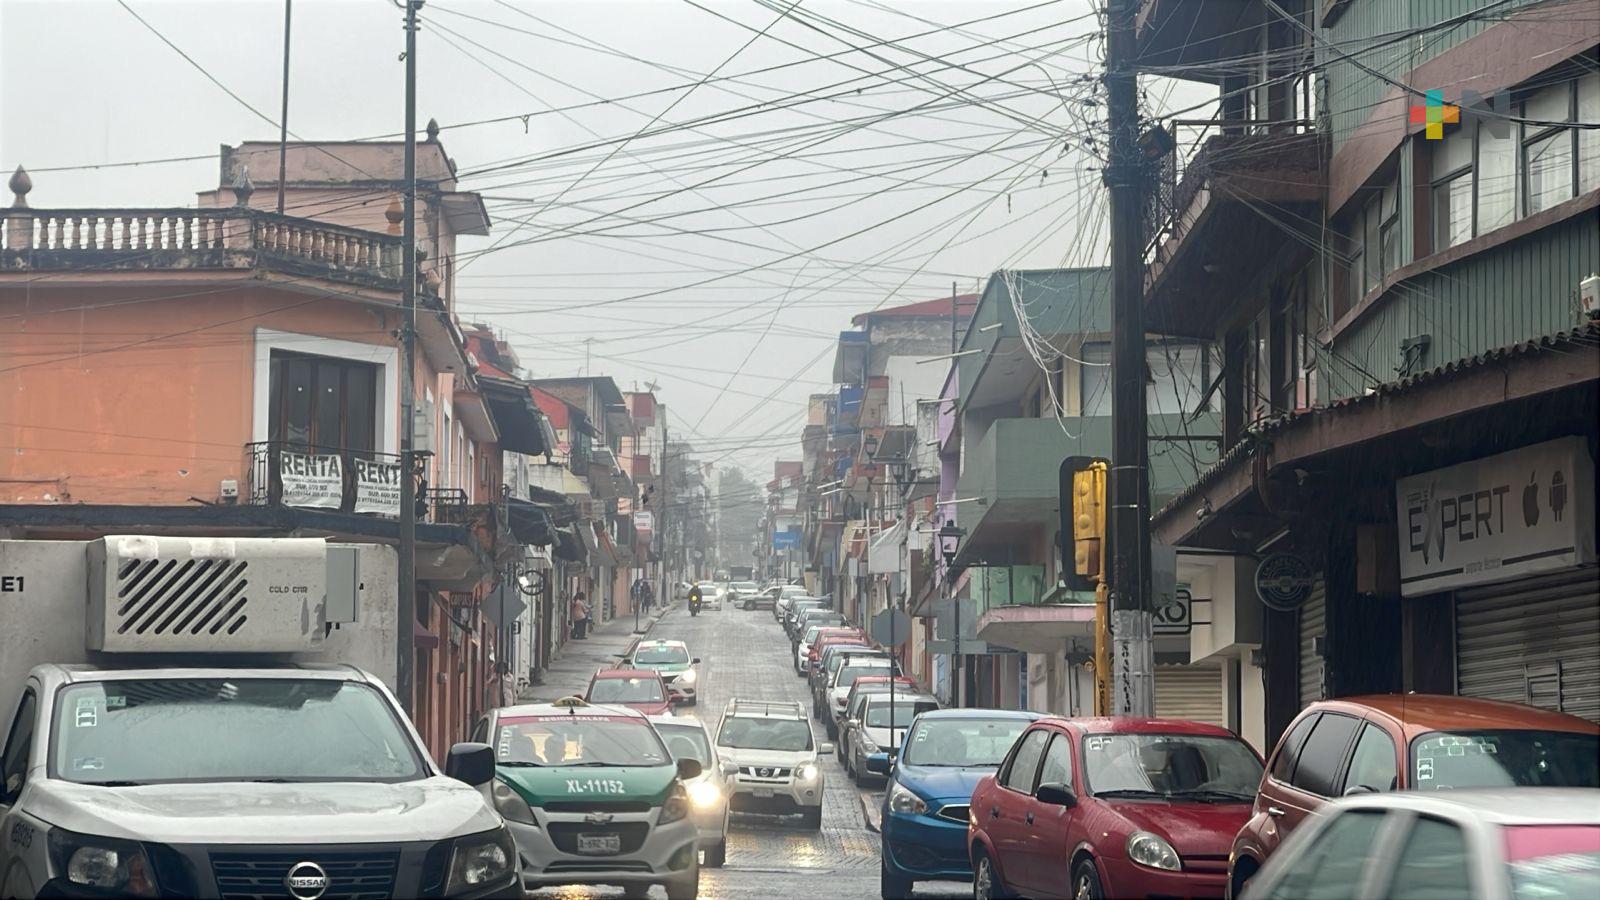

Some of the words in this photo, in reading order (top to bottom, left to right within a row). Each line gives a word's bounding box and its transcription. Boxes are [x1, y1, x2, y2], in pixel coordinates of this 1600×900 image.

[281, 455, 340, 478] RENTA
[355, 459, 401, 485] RENT
[1408, 484, 1510, 565] EXPERT
[1, 576, 24, 592] E1
[269, 586, 289, 594] COLD
[565, 779, 626, 794] XL-11152
[289, 879, 326, 887] NISSAN
